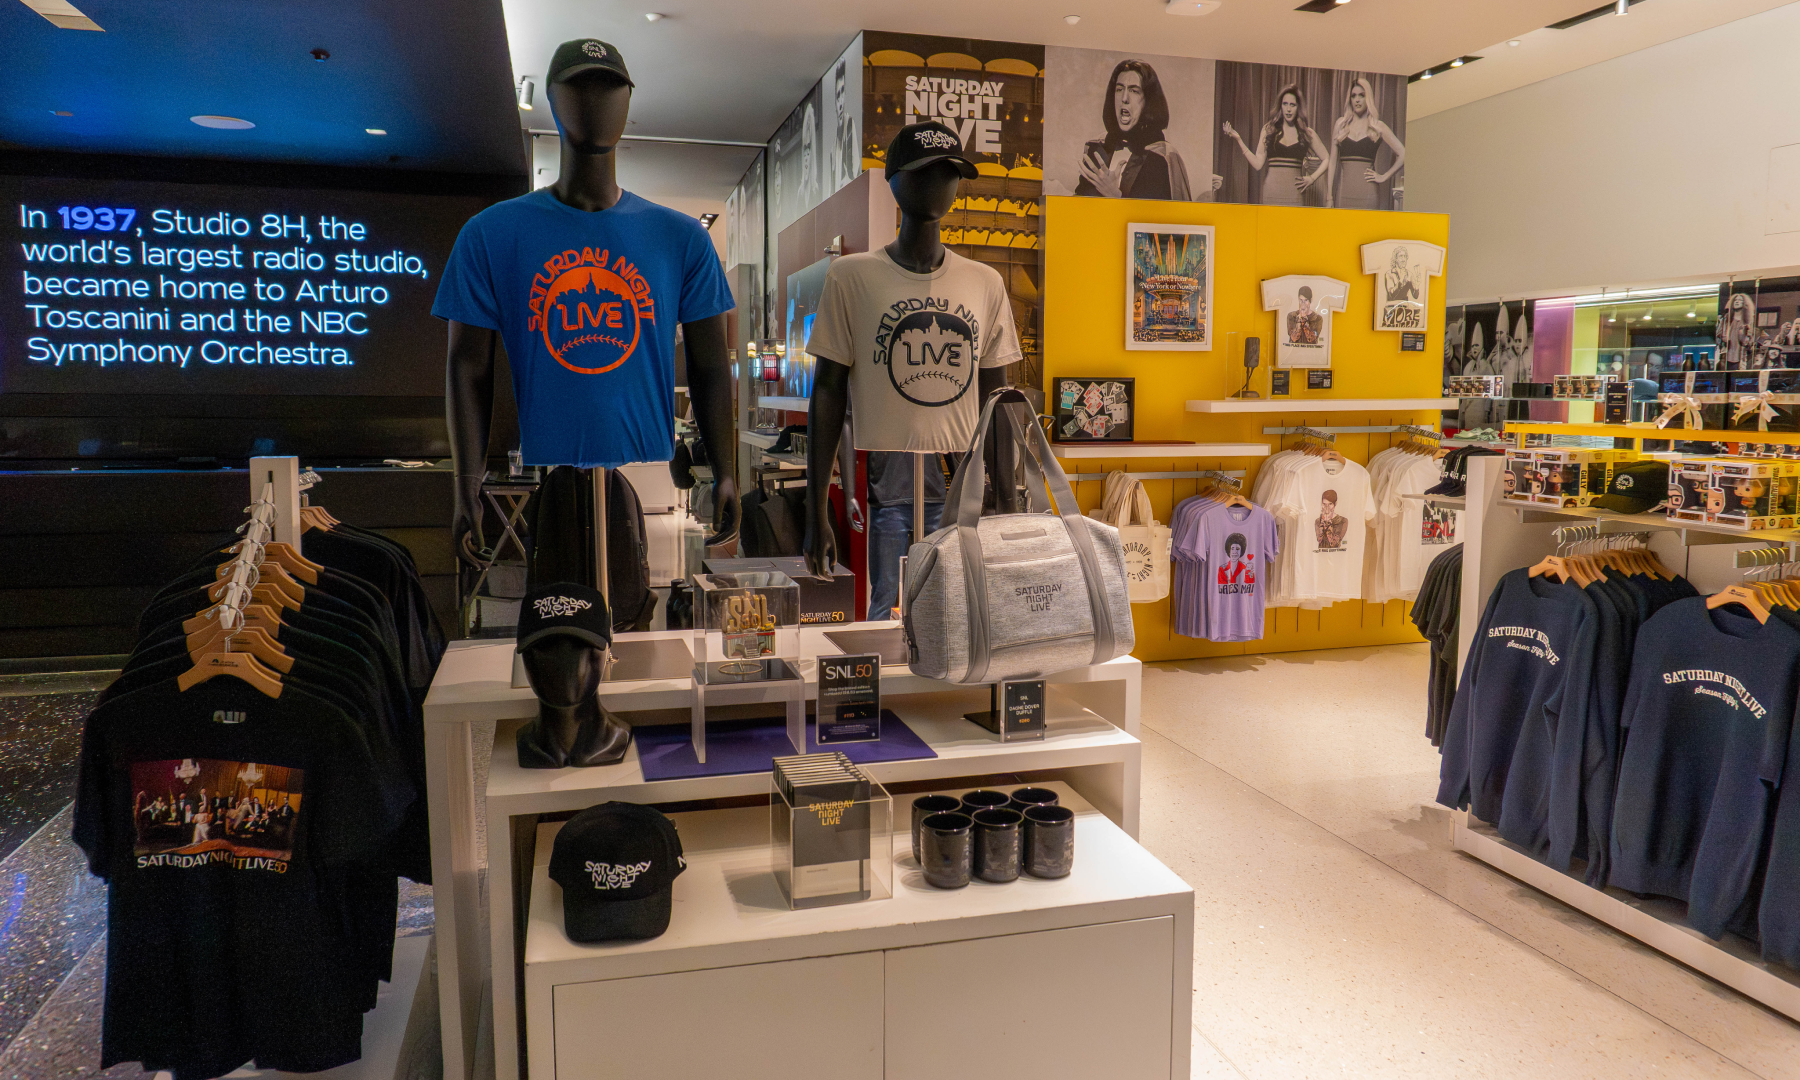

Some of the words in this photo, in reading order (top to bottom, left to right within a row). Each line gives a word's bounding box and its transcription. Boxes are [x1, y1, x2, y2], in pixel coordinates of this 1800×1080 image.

[905, 75, 1004, 97] SATURDAY
[905, 90, 1004, 120] NIGHT
[20, 205, 47, 229] In
[57, 206, 144, 236] 1937,
[152, 209, 250, 237] Studio
[260, 214, 312, 243] 8H,
[319, 216, 366, 241] the
[21, 240, 131, 265] world's
[141, 241, 243, 272] largest
[252, 246, 325, 271] radio
[335, 251, 429, 279] studio,
[23, 270, 150, 298] became
[160, 274, 246, 300] home
[254, 278, 285, 301] to
[295, 279, 389, 304] Arturo
[528, 246, 609, 332] SATURDAY
[612, 256, 655, 325] NIGHT
[25, 304, 170, 331] Toscanini
[180, 307, 236, 333] and
[243, 310, 291, 333] the
[300, 312, 369, 335] NBC
[557, 302, 623, 331] LIVE
[873, 297, 949, 365] SATURDAY
[27, 337, 192, 368] Symphony
[201, 340, 354, 366] Orchestra.
[902, 342, 962, 367] LIVE
[1580, 469, 1588, 489] GILLY
[1422, 521, 1455, 538] SNL
[1122, 542, 1151, 557] ATURDAY
[1015, 584, 1062, 596] SATURDAY
[533, 595, 592, 609] SATURDAY
[1026, 593, 1053, 604] NIGHT
[540, 604, 581, 614] NIGHT
[541, 610, 573, 619] LIVE
[1031, 602, 1050, 612] LIVE
[831, 611, 844, 622] 50
[1488, 626, 1537, 639] SATURDAY
[1507, 640, 1530, 651] Season
[1663, 670, 1724, 684] SATURDAY
[1740, 692, 1766, 719] LIVE
[1694, 685, 1721, 698] Season
[809, 799, 854, 812] SATURDAY
[818, 808, 844, 819] NIGHT
[822, 816, 841, 826] LIVE
[137, 851, 210, 868] SATURDAY
[584, 860, 651, 875] SATURDAY
[592, 872, 640, 884] NIGHT
[594, 880, 631, 890] LIVE
